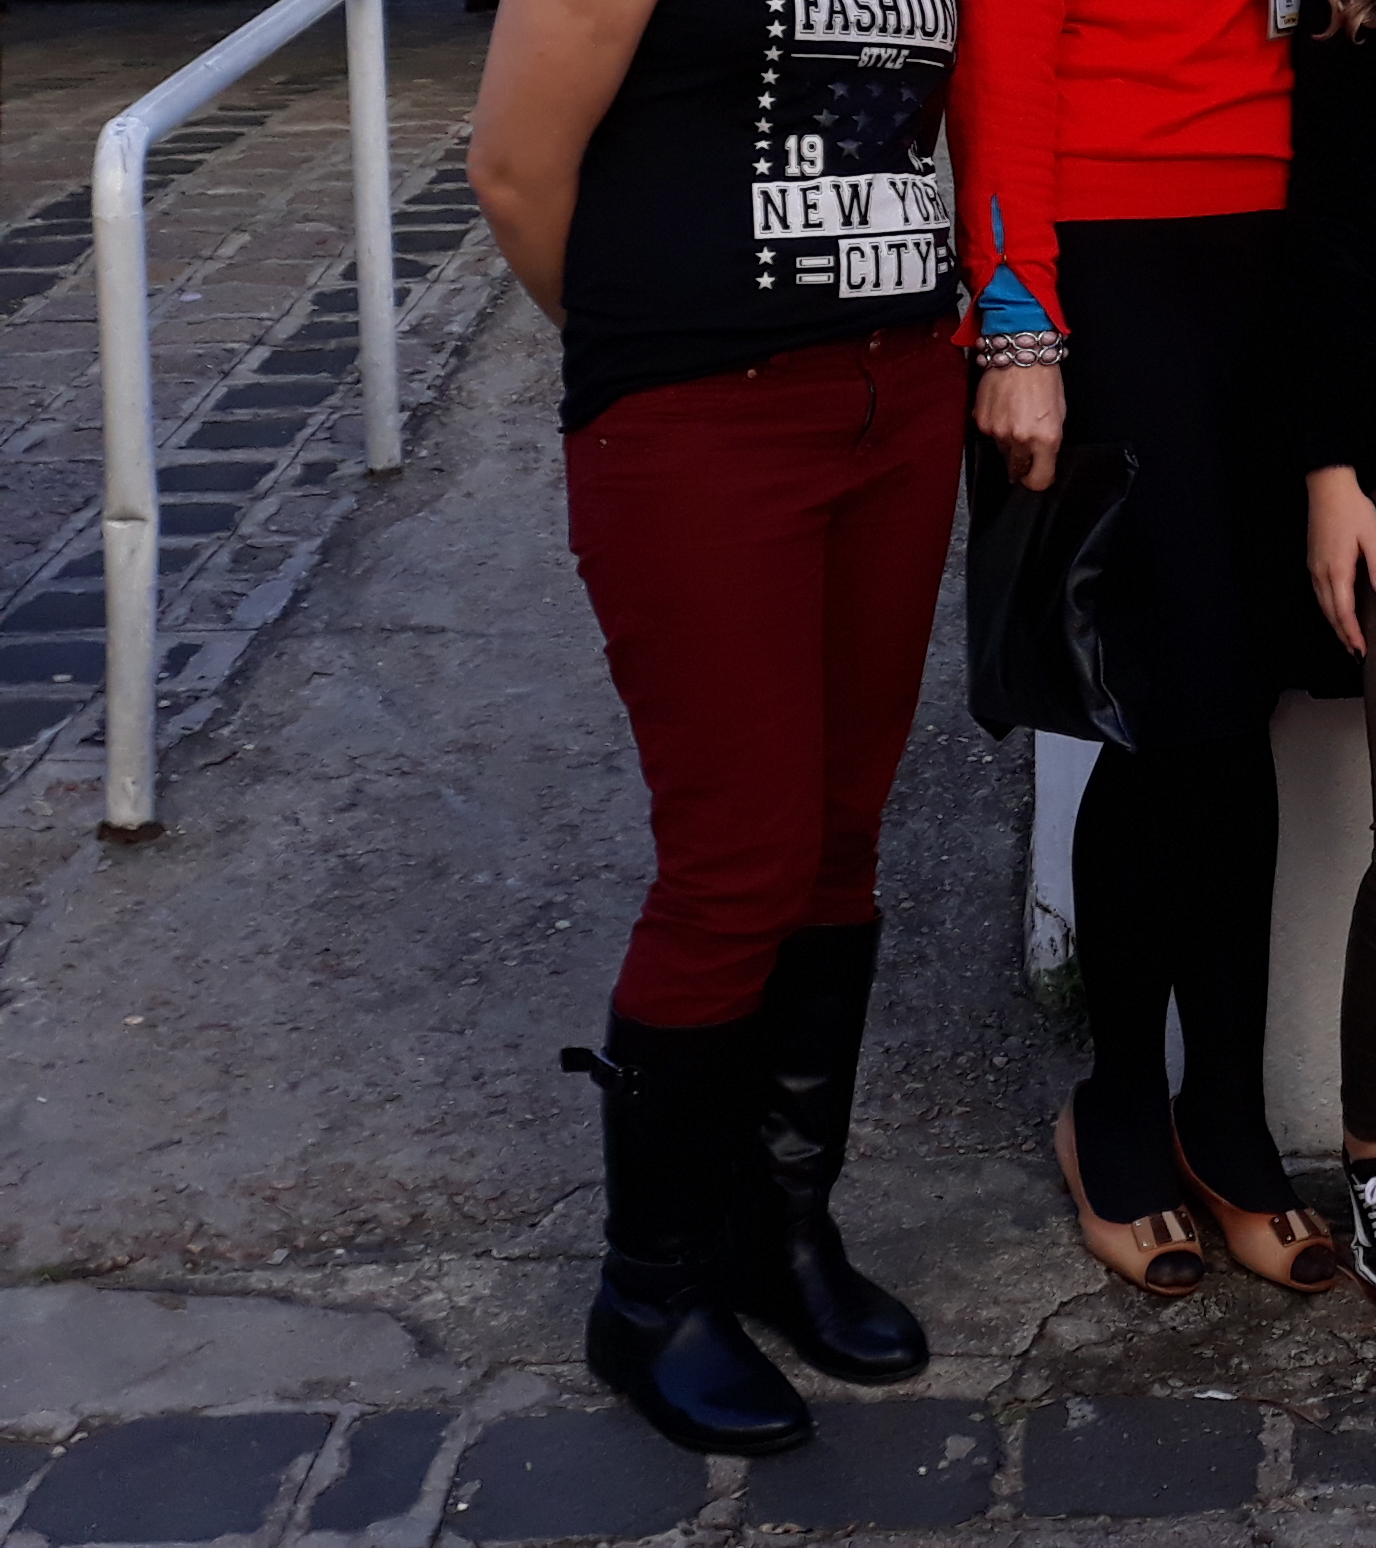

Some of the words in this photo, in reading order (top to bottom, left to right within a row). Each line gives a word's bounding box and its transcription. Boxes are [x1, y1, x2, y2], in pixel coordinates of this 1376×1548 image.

[858, 47, 909, 69] STYLE
[757, 178, 873, 233] NEW
[888, 176, 950, 228] YOR
[844, 239, 935, 292] CITY
